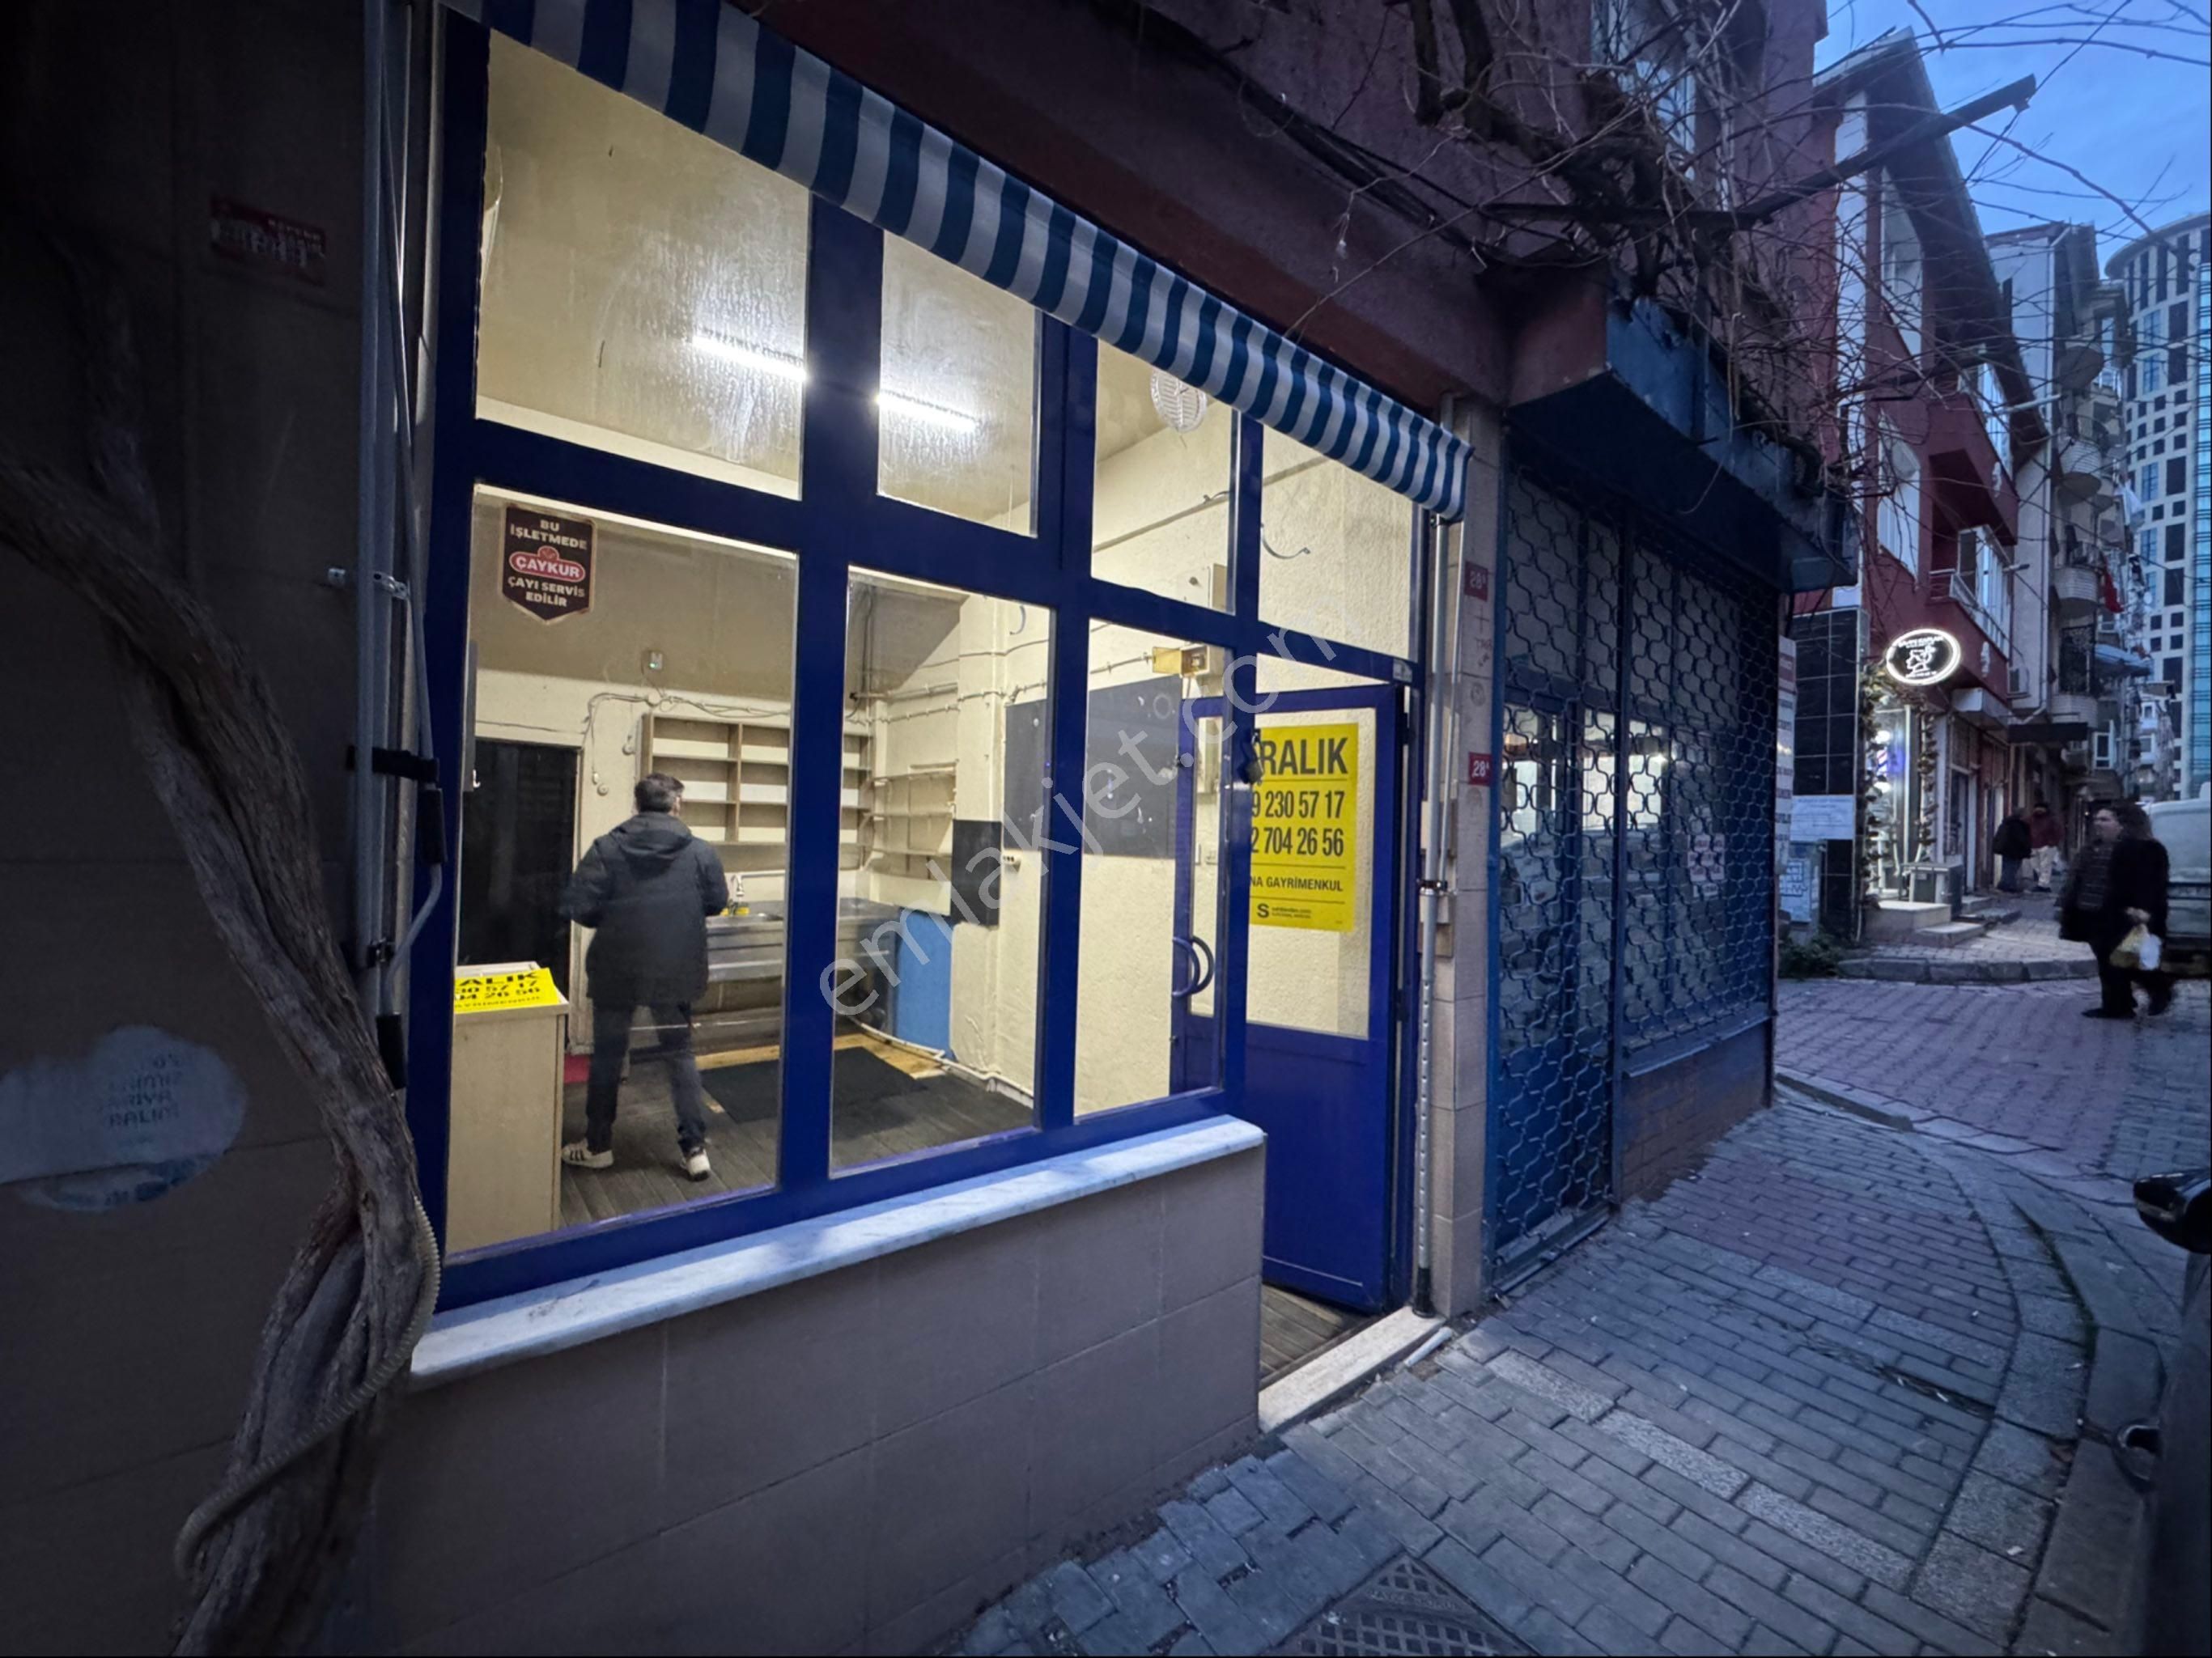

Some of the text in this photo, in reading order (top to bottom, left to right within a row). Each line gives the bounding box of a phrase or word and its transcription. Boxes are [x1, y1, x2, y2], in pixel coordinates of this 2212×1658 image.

[541, 519, 559, 532] BU
[516, 555, 580, 578] ÇAYKUR
[507, 576, 585, 597] ÇAYI SERVİS
[525, 592, 567, 607] EDİLİR
[1265, 791, 1294, 818] 230
[1298, 791, 1318, 818] 57
[1325, 791, 1345, 819] 17
[1264, 827, 1293, 854] 704
[1297, 828, 1318, 856] 26
[1322, 828, 1344, 857] 56
[1266, 876, 1344, 892] GAYRİMENKUL
